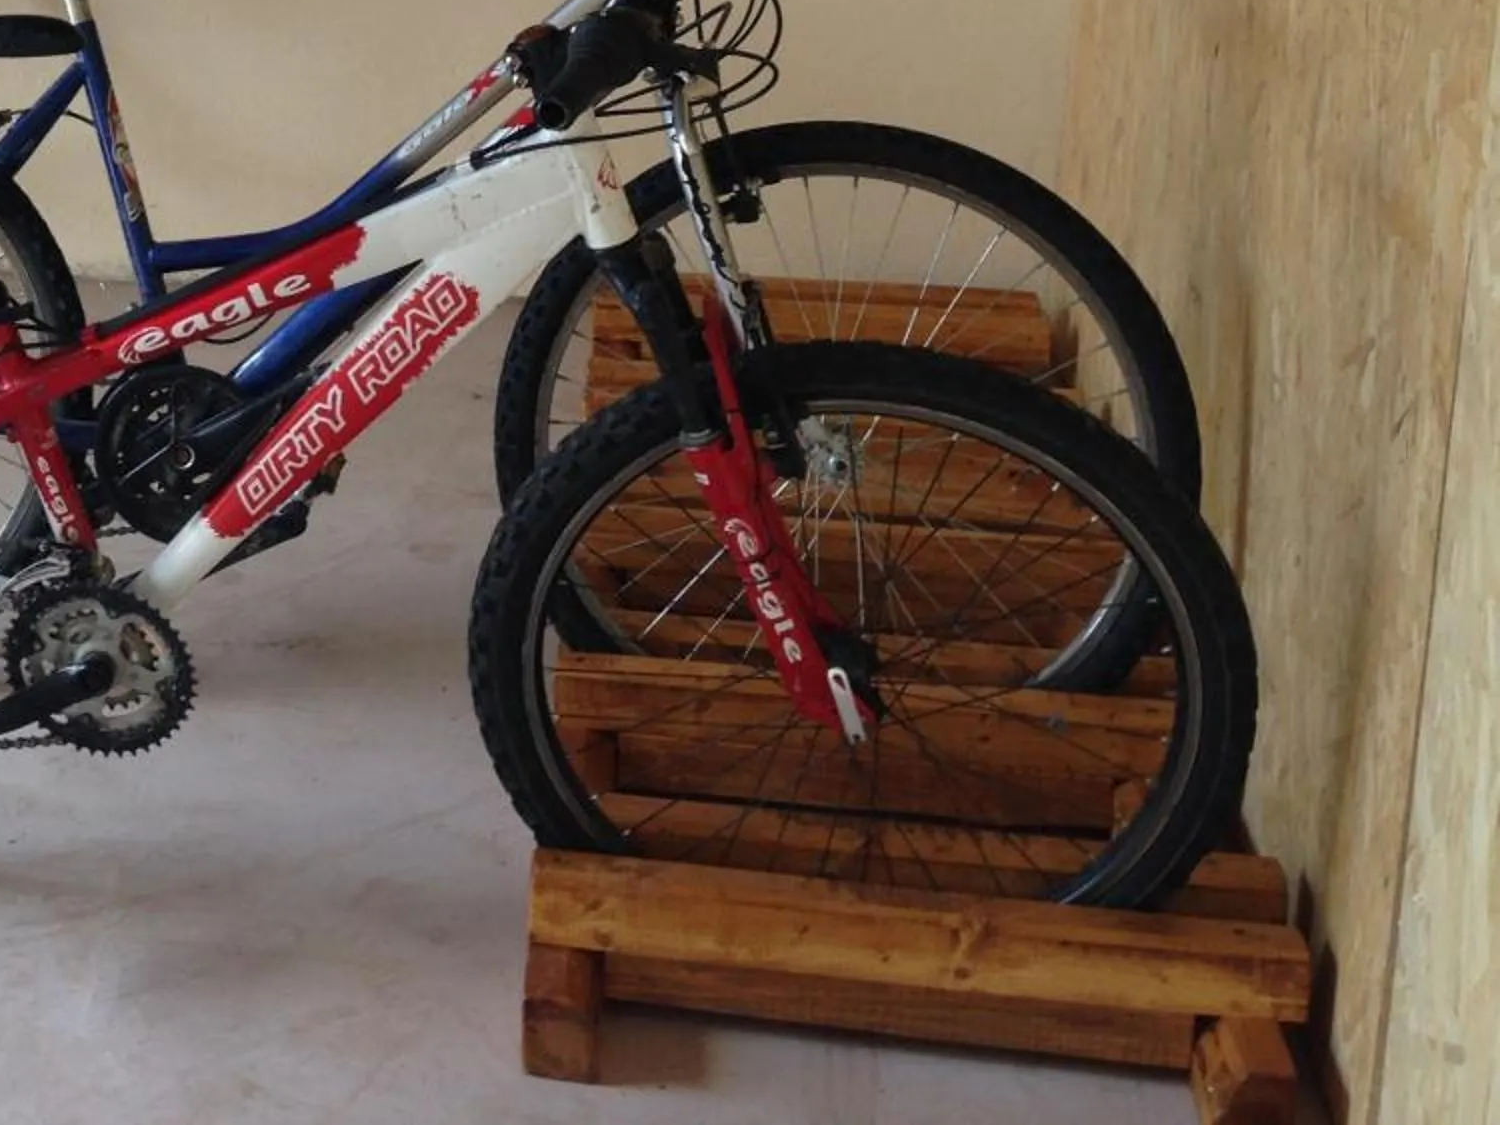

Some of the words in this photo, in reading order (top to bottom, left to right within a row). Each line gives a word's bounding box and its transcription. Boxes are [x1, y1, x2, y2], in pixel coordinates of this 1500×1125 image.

[118, 272, 312, 364] eagle
[234, 384, 346, 516] DIRTY
[346, 275, 468, 405] ROAD
[36, 455, 80, 543] eagle
[723, 517, 803, 664] eagle
